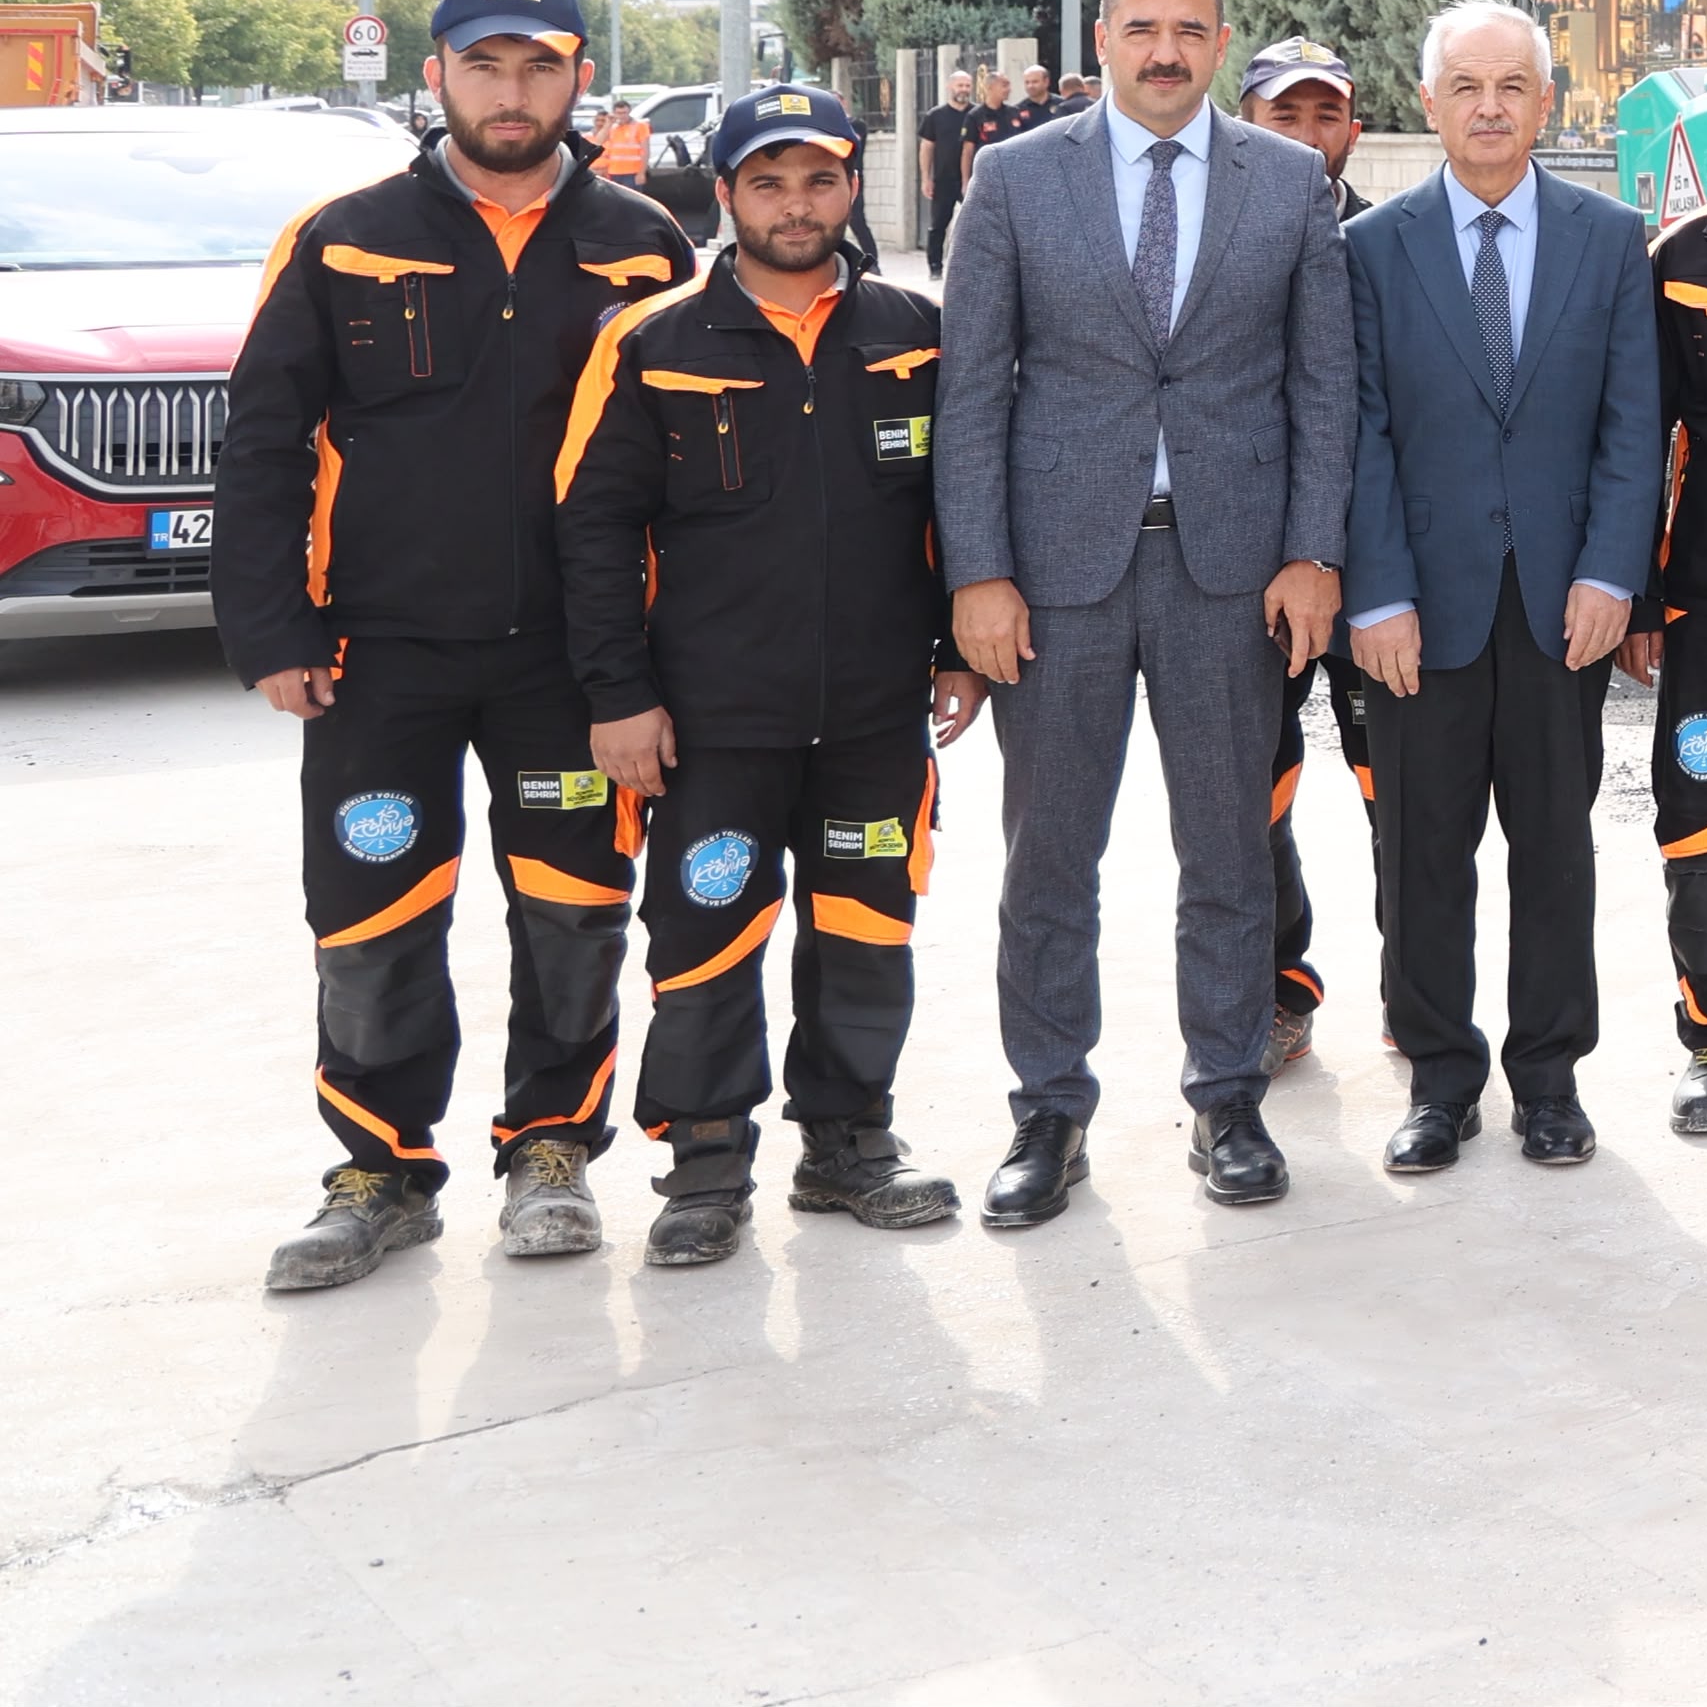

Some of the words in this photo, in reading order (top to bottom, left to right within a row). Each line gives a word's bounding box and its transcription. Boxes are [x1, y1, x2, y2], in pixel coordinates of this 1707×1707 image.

[353, 25, 378, 41] 60
[152, 532, 169, 542] TR
[171, 513, 211, 545] 42
[522, 780, 560, 790] BENİM
[828, 829, 863, 841] BENİM
